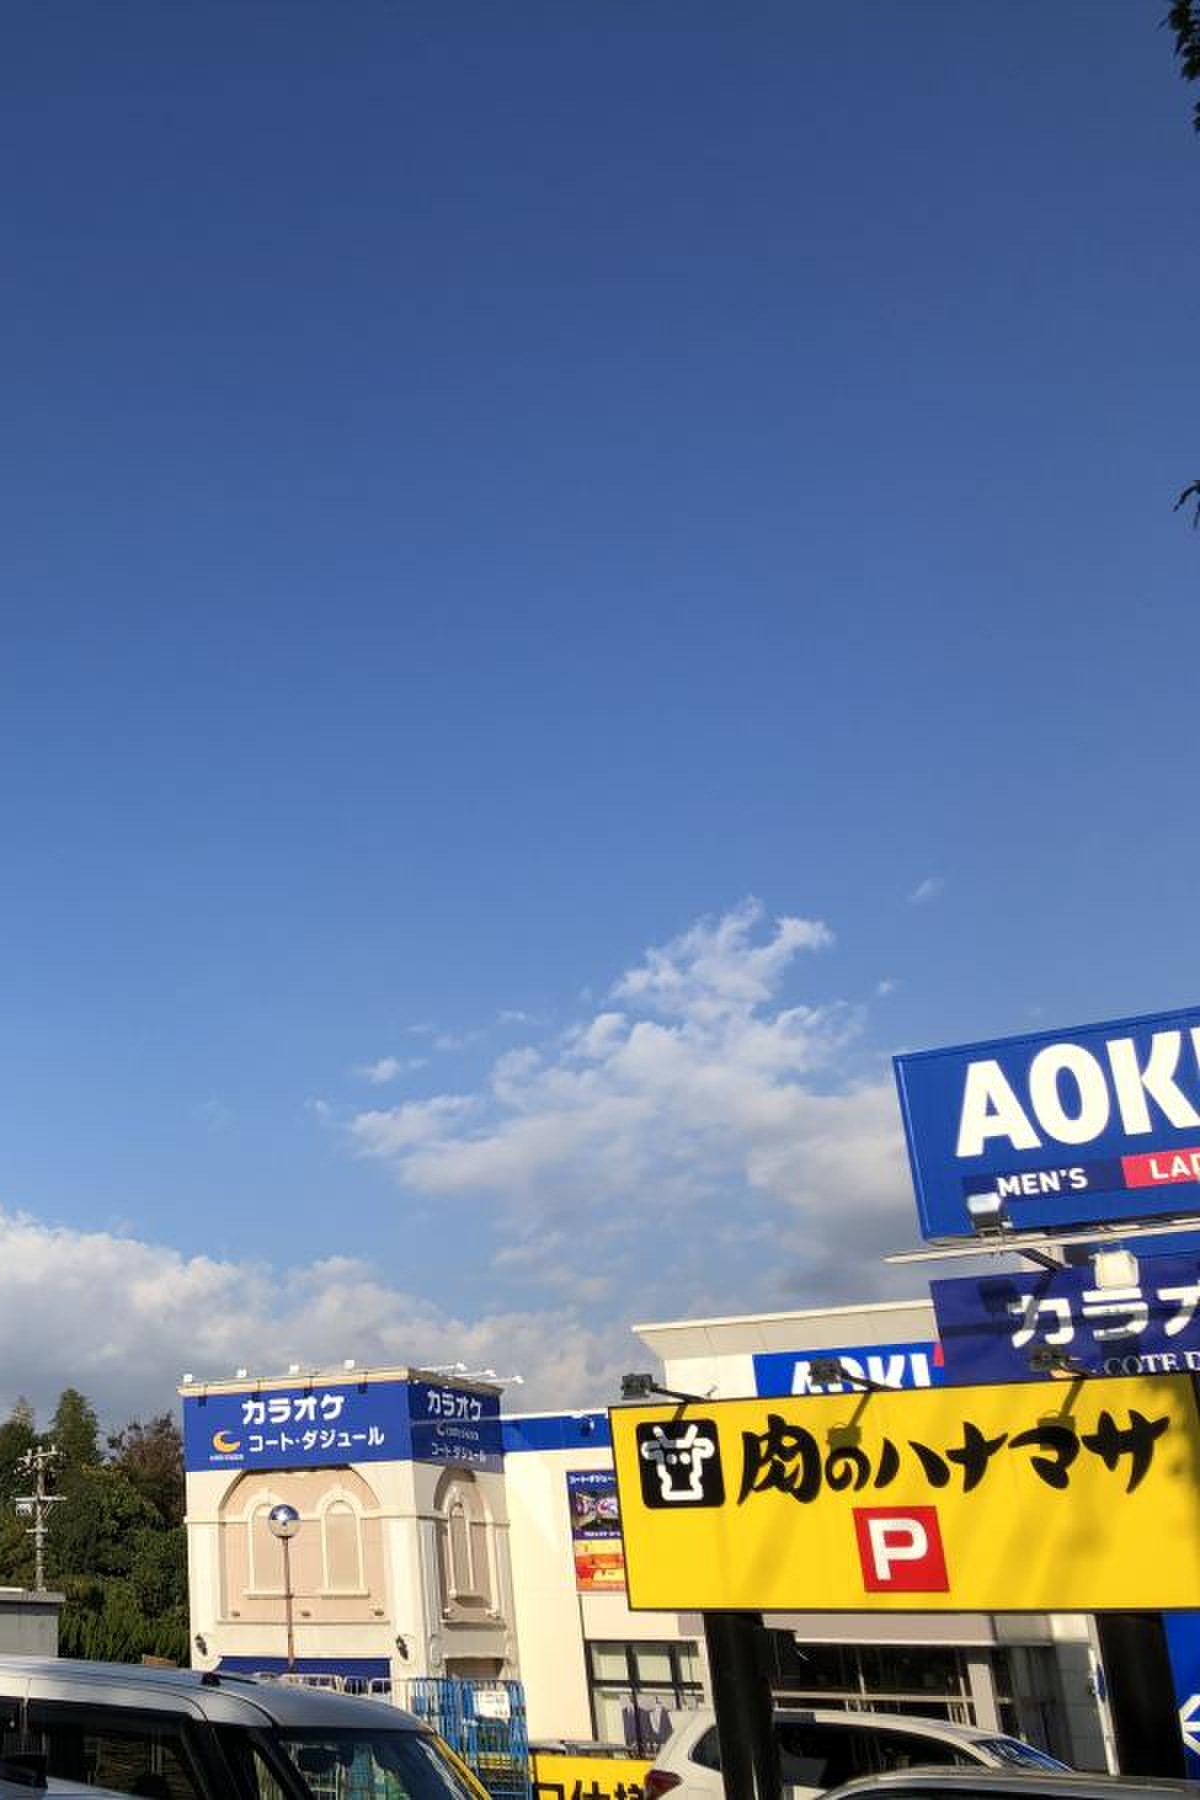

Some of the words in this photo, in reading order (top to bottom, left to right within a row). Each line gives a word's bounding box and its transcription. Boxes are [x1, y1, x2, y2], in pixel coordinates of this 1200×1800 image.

[997, 1167, 1088, 1197] MEN'S
[241, 1393, 345, 1425] カラオケ
[427, 1390, 482, 1421] カラオケ
[737, 1409, 1170, 1505] 肉のハナマサ
[868, 1518, 929, 1581] P
